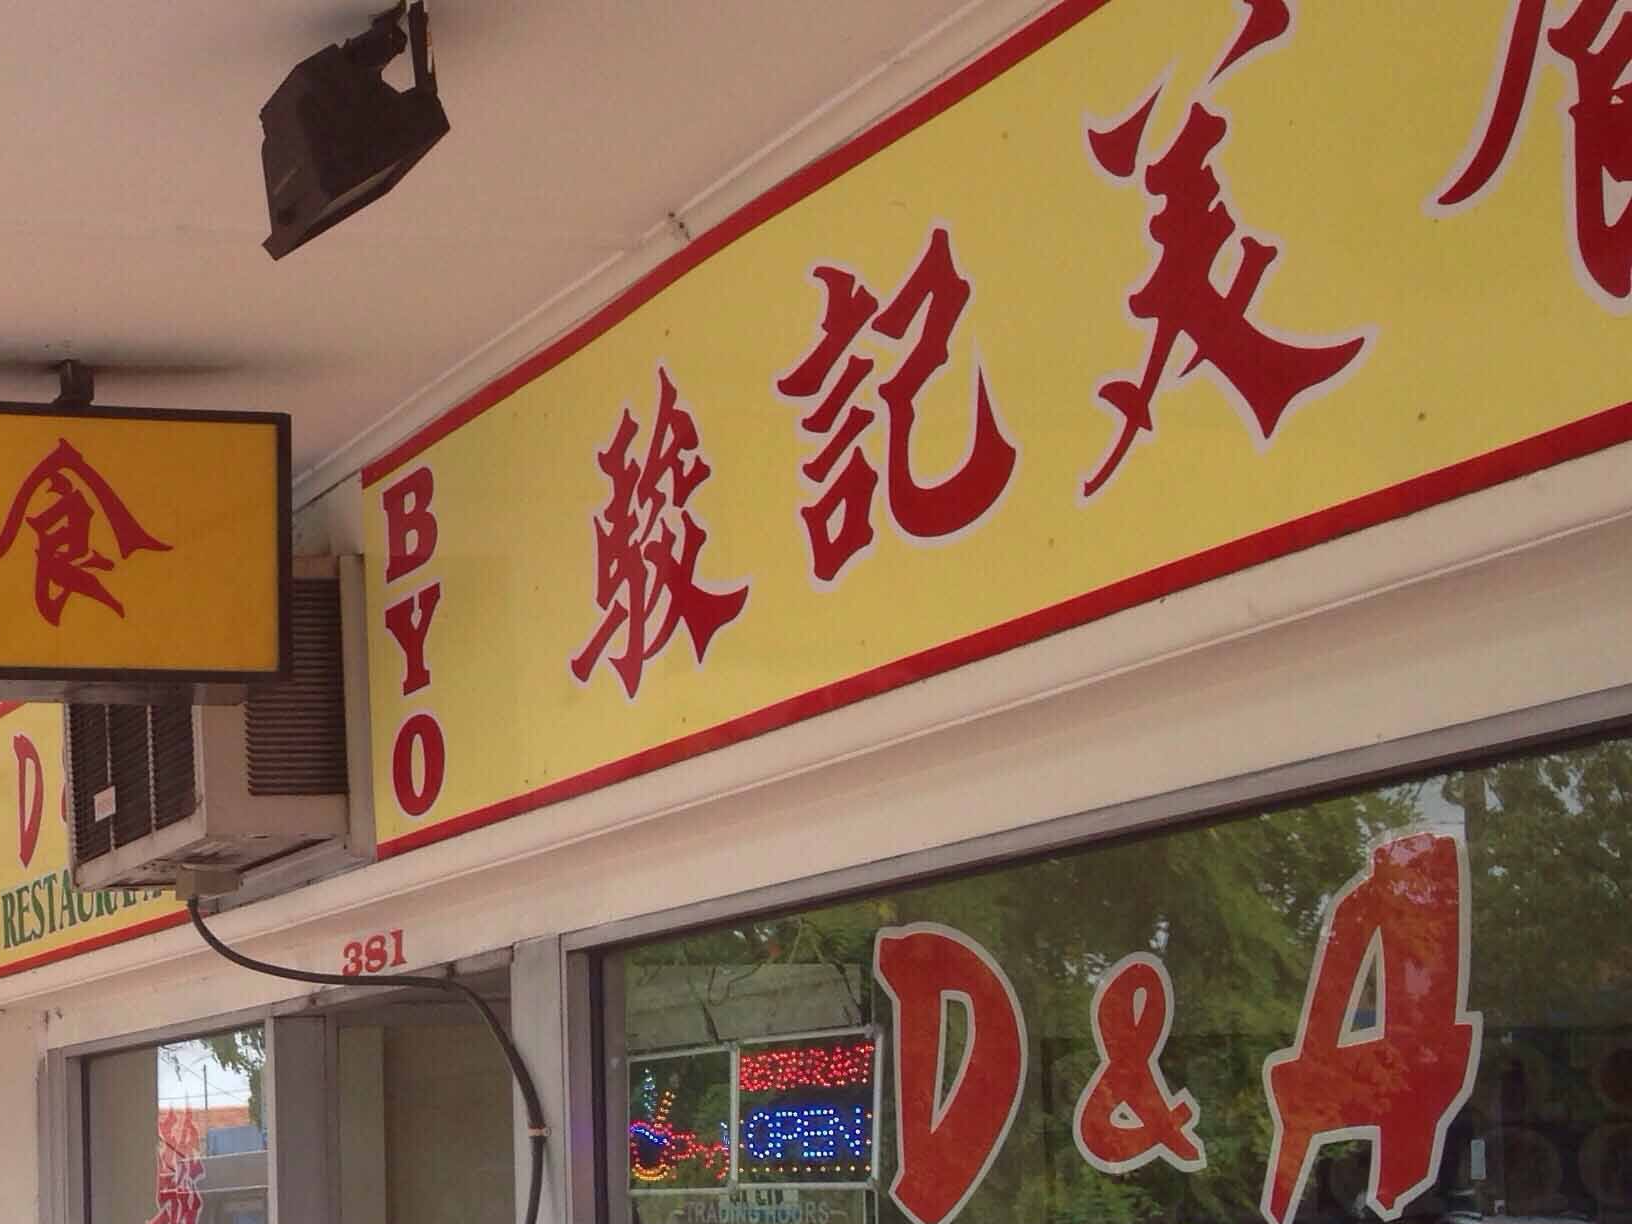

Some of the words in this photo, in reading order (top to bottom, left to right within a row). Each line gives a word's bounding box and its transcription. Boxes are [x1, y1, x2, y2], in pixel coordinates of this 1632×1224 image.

[385, 465, 445, 817] BYO
[13, 733, 44, 869] D
[1, 868, 163, 949] RESTAU
[342, 929, 406, 977] 381
[1073, 951, 1206, 1172] &
[748, 1105, 862, 1160] OPEN
